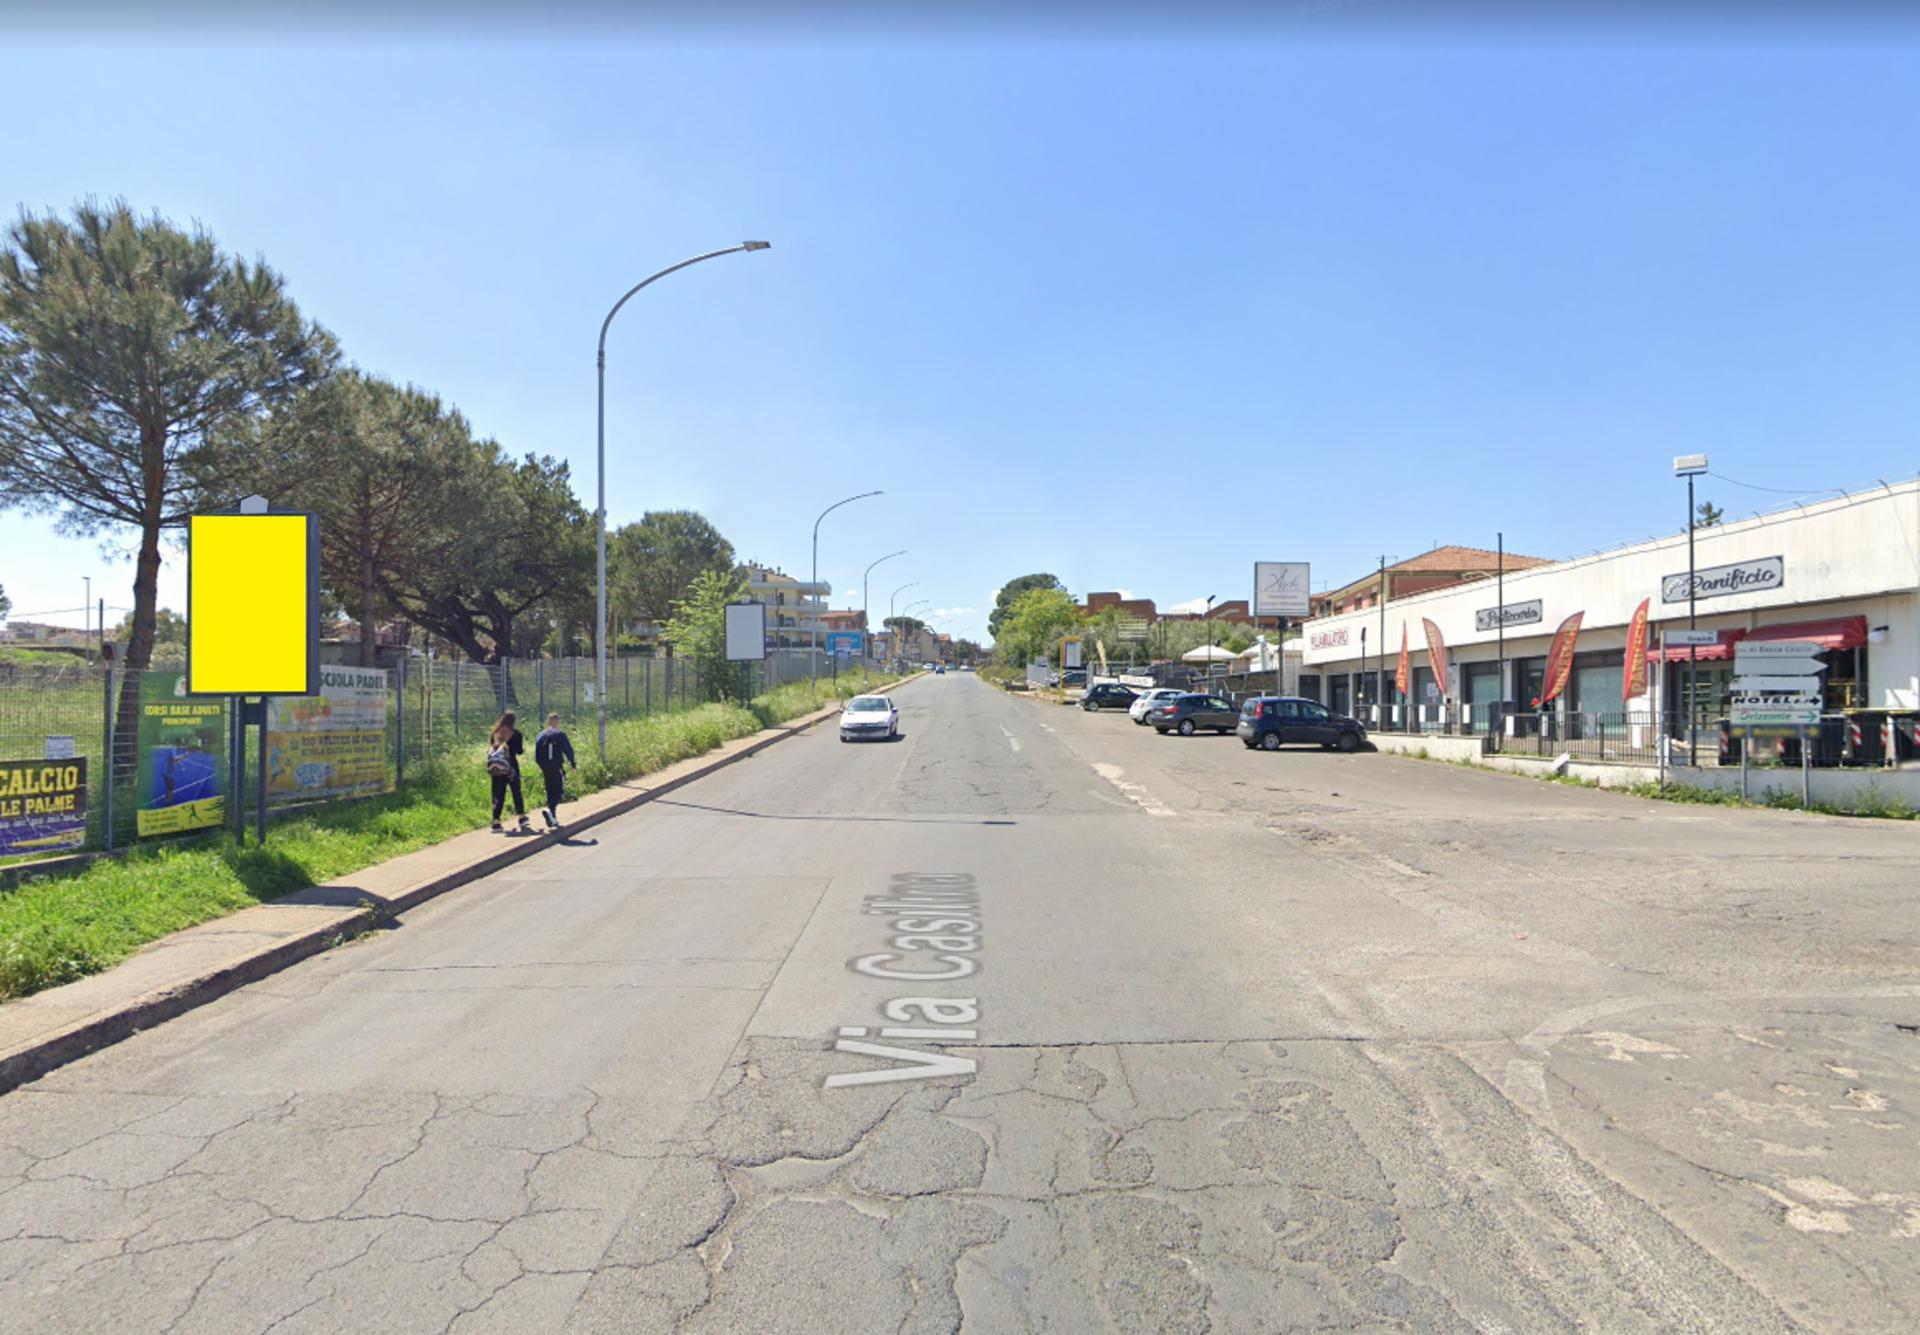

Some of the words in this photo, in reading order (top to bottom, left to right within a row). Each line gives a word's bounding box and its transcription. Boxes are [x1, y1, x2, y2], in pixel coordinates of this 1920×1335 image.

[1681, 568, 1776, 597] Panificio
[0, 766, 78, 797] CALCIO
[1, 800, 20, 816] LE
[25, 795, 75, 815] PALME
